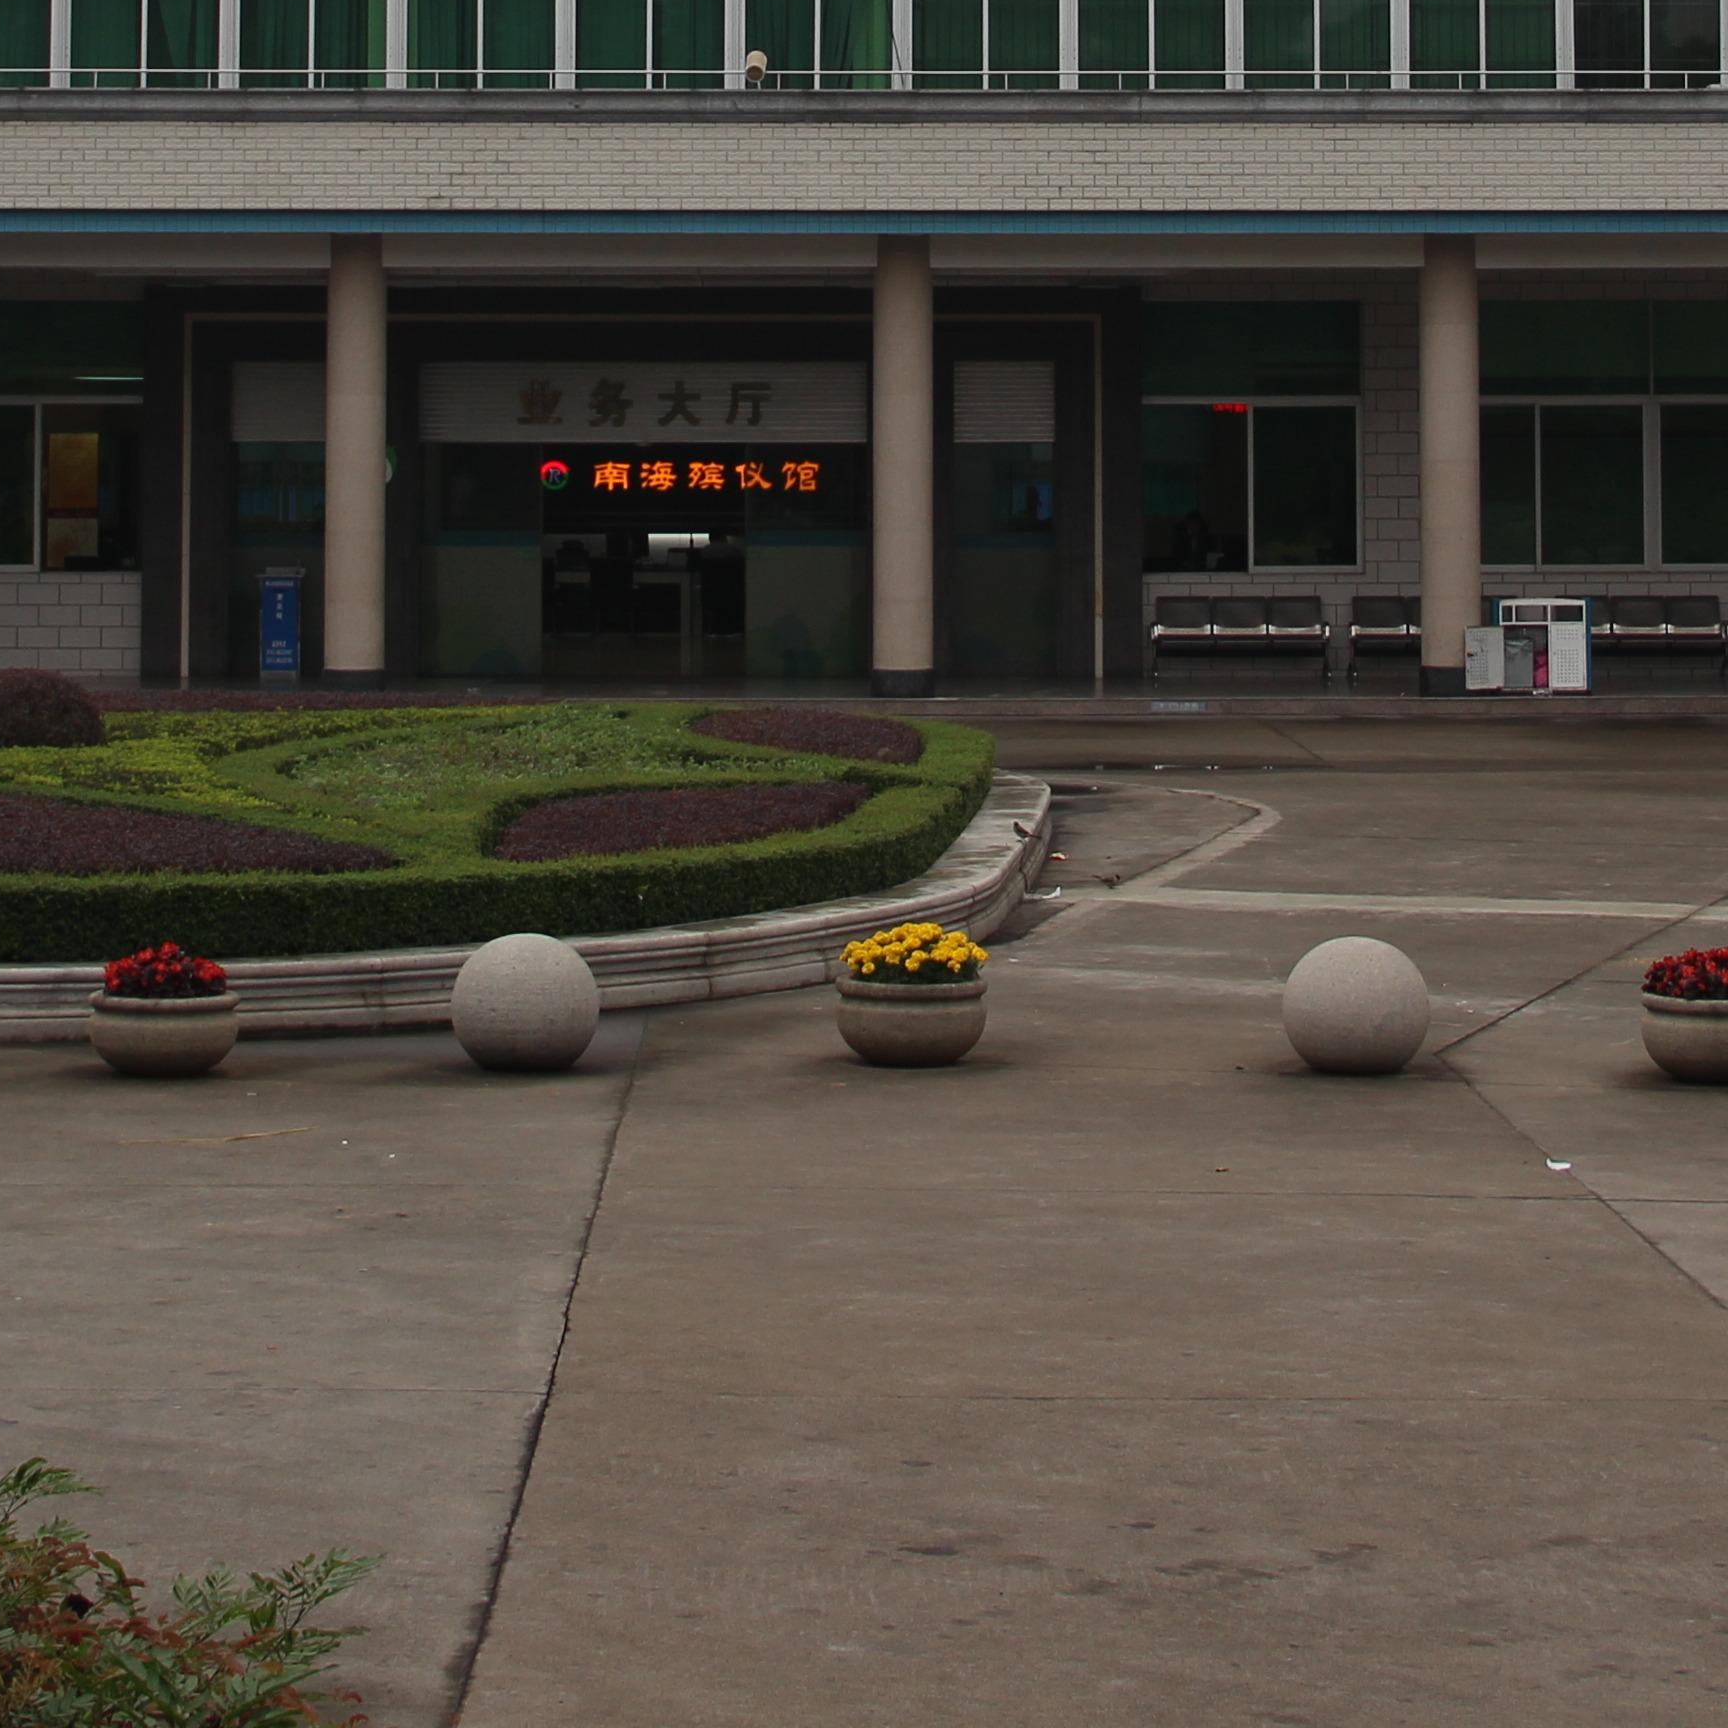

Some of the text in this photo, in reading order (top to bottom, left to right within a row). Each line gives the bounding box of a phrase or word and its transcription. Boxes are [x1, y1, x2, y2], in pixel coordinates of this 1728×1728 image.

[516, 378, 773, 427] 业务大厅
[592, 460, 821, 492] 南海殡仪馆
